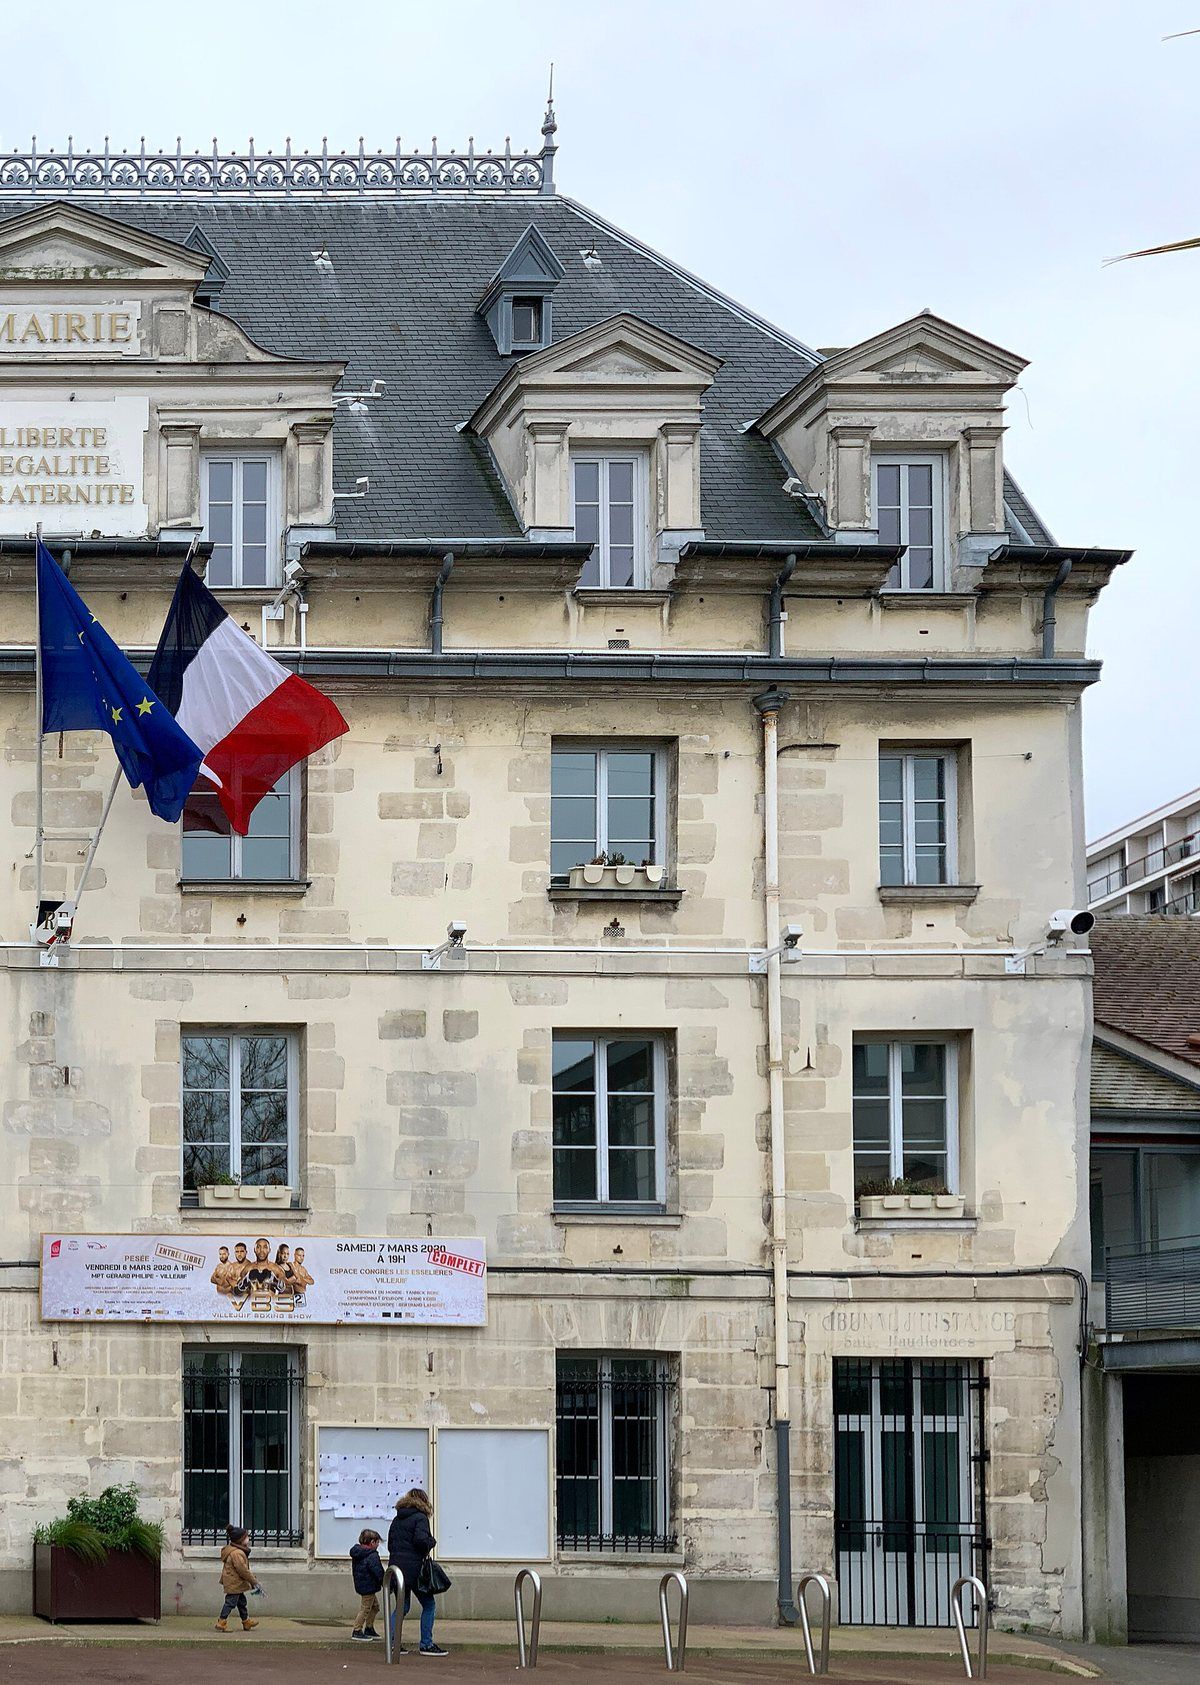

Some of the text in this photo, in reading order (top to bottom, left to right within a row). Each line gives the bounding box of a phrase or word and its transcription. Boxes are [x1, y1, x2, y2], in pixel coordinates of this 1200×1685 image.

[0, 427, 108, 448] LIBERTE
[0, 455, 111, 477] EGALITE
[124, 1254, 150, 1262] PESÉE
[336, 1243, 446, 1254] SAMEDI 7 MARS 2020
[377, 1253, 406, 1264] À 19H
[432, 1251, 481, 1274] COMPLET
[227, 1293, 295, 1312] VBS
